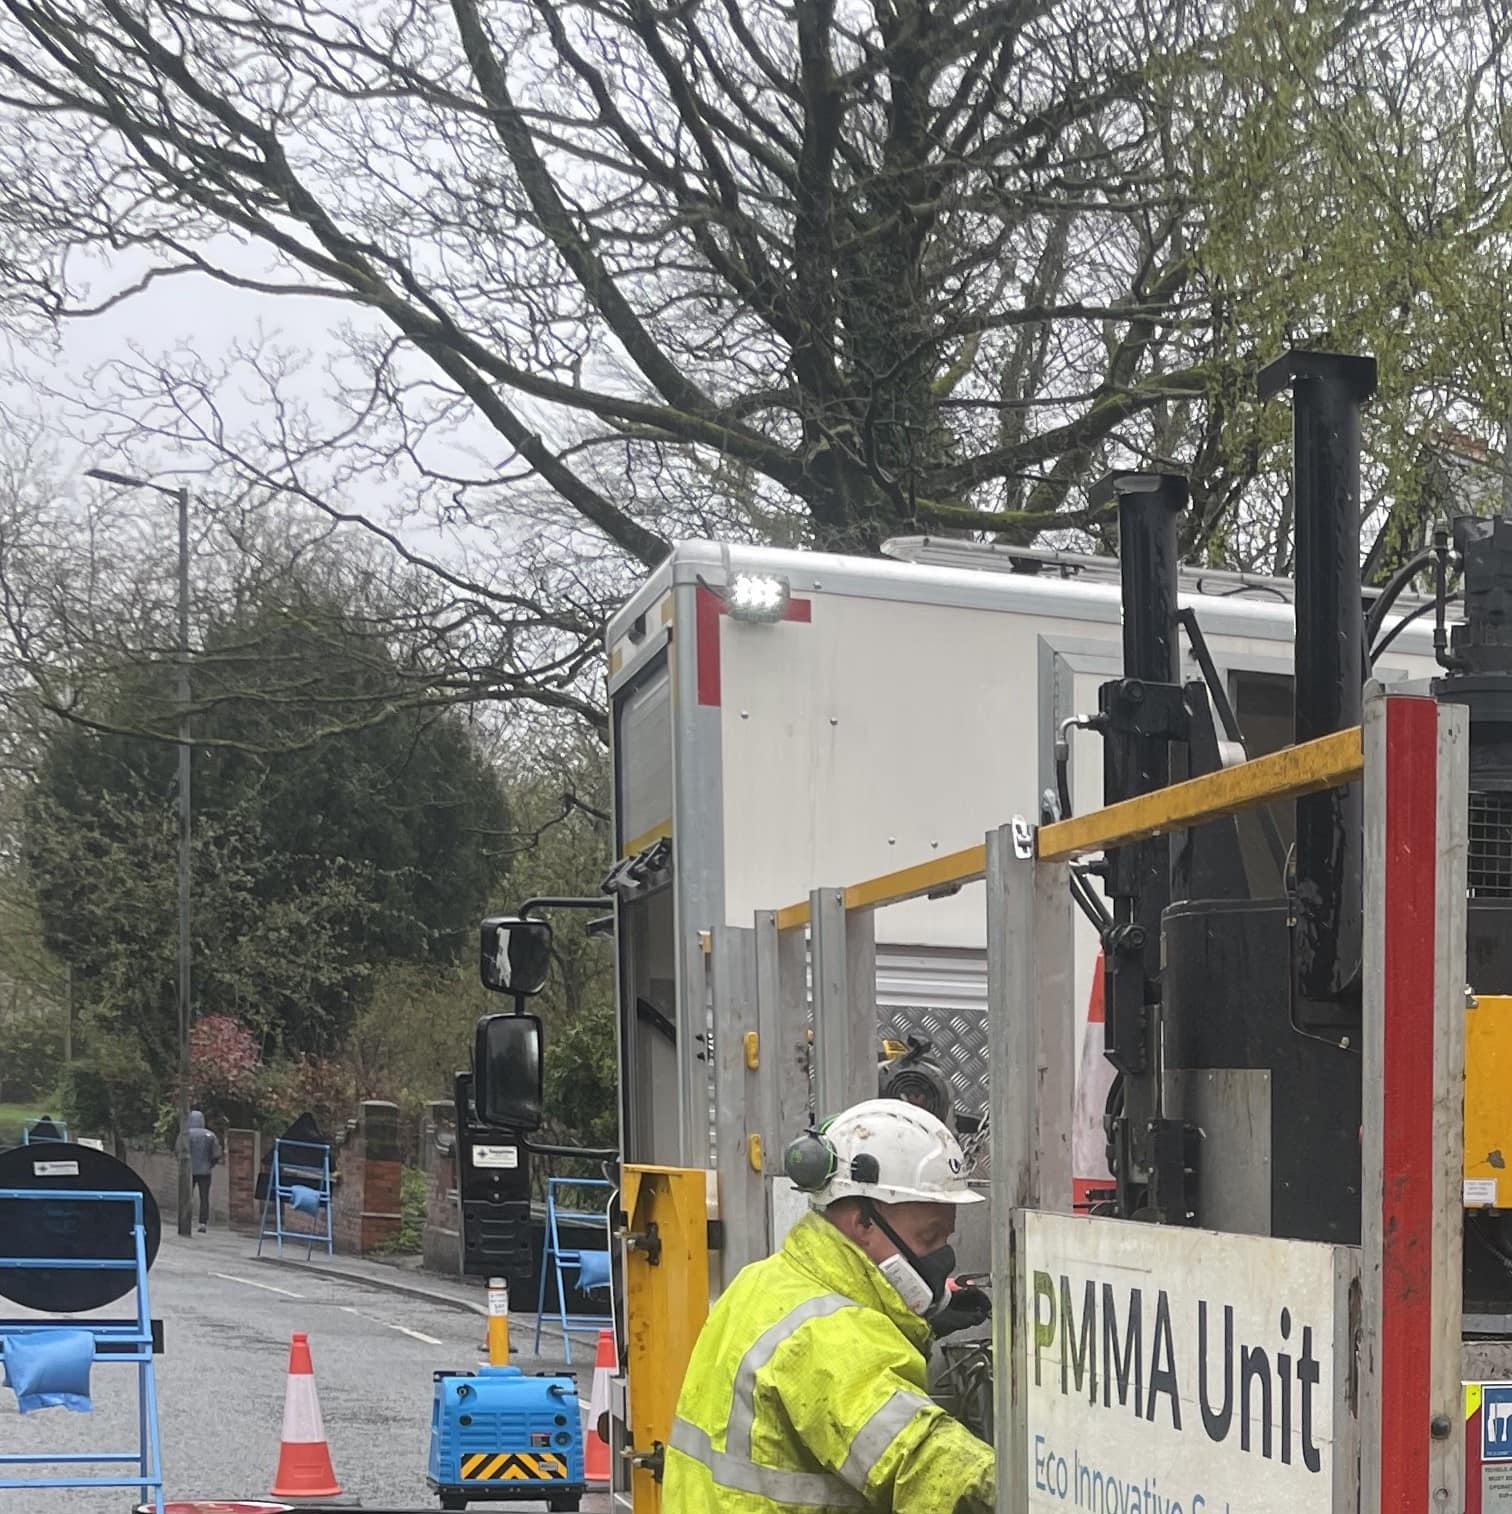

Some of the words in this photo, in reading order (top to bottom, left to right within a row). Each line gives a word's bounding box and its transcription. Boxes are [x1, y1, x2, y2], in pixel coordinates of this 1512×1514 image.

[1033, 1270, 1183, 1430] PMMA
[1198, 1300, 1322, 1474] Unit
[1035, 1434, 1069, 1500] Eco
